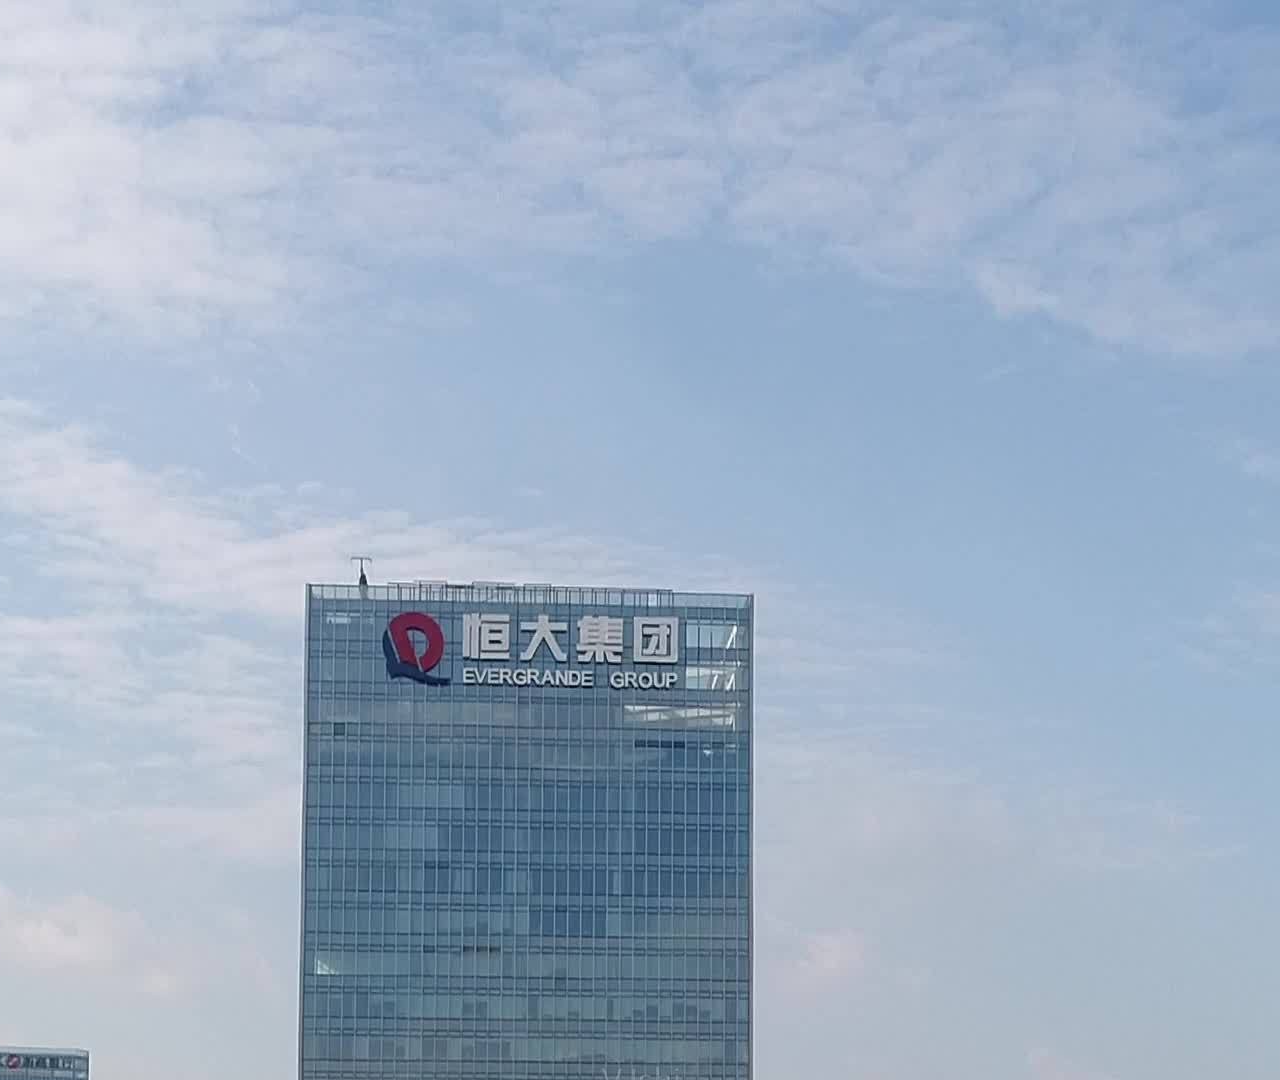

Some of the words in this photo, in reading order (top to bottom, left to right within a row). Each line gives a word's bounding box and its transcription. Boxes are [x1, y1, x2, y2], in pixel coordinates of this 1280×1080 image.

[463, 613, 679, 664] 恒大集团
[463, 668, 593, 687] EVERGRANDE
[610, 671, 678, 689] GROUP
